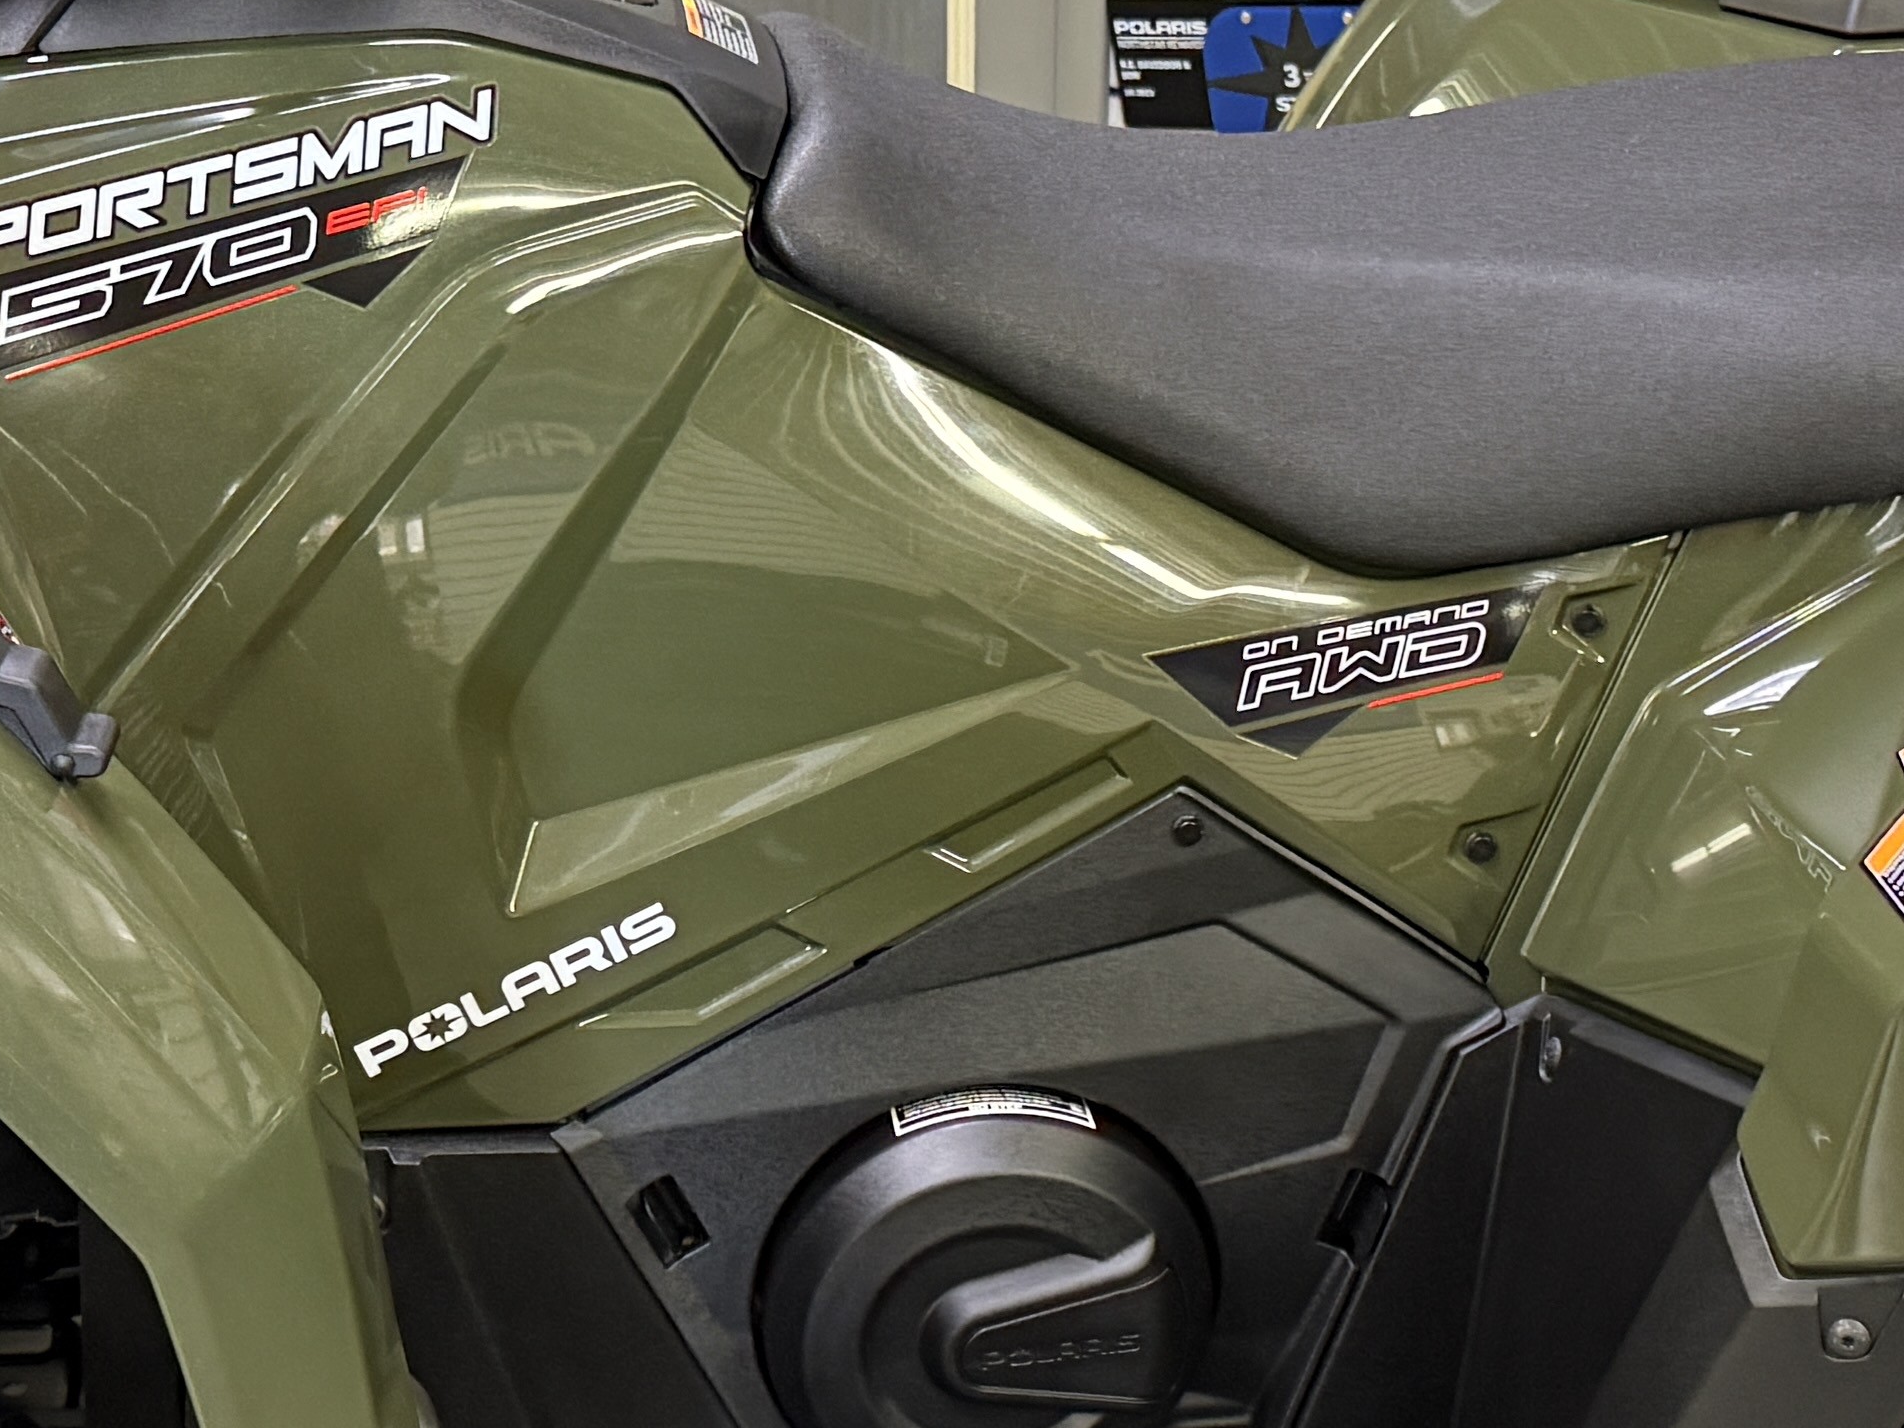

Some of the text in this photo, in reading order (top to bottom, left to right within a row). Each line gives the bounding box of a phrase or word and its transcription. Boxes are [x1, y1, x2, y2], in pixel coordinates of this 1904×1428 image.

[1113, 19, 1209, 36] POLARIS
[1236, 621, 1487, 713] AWD
[1242, 598, 1490, 661] ON DEMAND
[352, 900, 677, 1079] POLARIS
